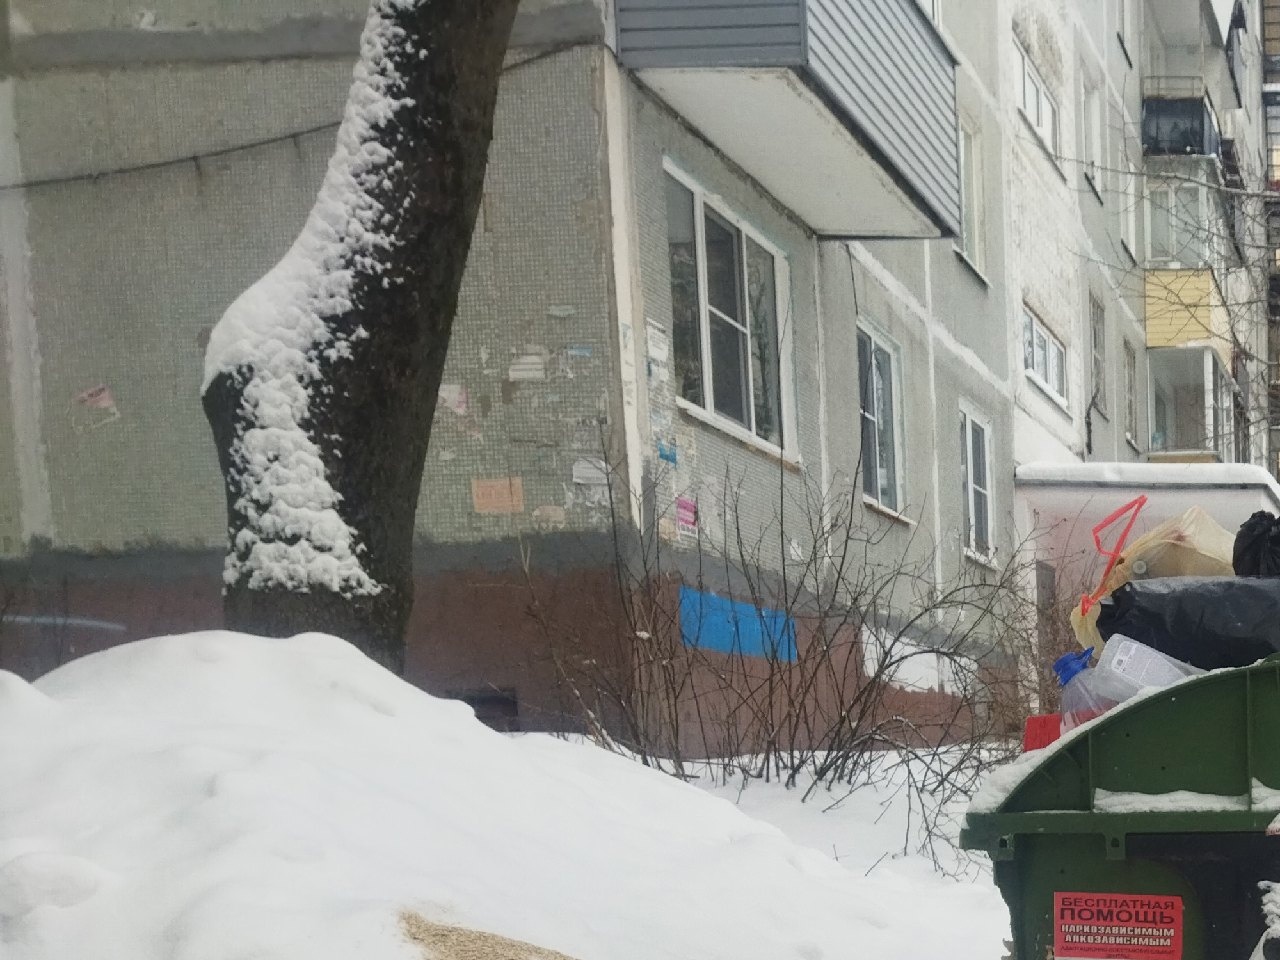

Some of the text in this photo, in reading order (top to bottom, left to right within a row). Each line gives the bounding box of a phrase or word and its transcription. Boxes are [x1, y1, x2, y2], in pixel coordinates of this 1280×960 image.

[1061, 897, 1175, 910] БЕСПЛАТНАЯ
[1060, 907, 1175, 925] ПОМОЩЬ
[1061, 924, 1175, 937] НАРКОЗАВИСИМЫМ
[1065, 934, 1171, 946] АЛКОЗАВИСИМЫМ
